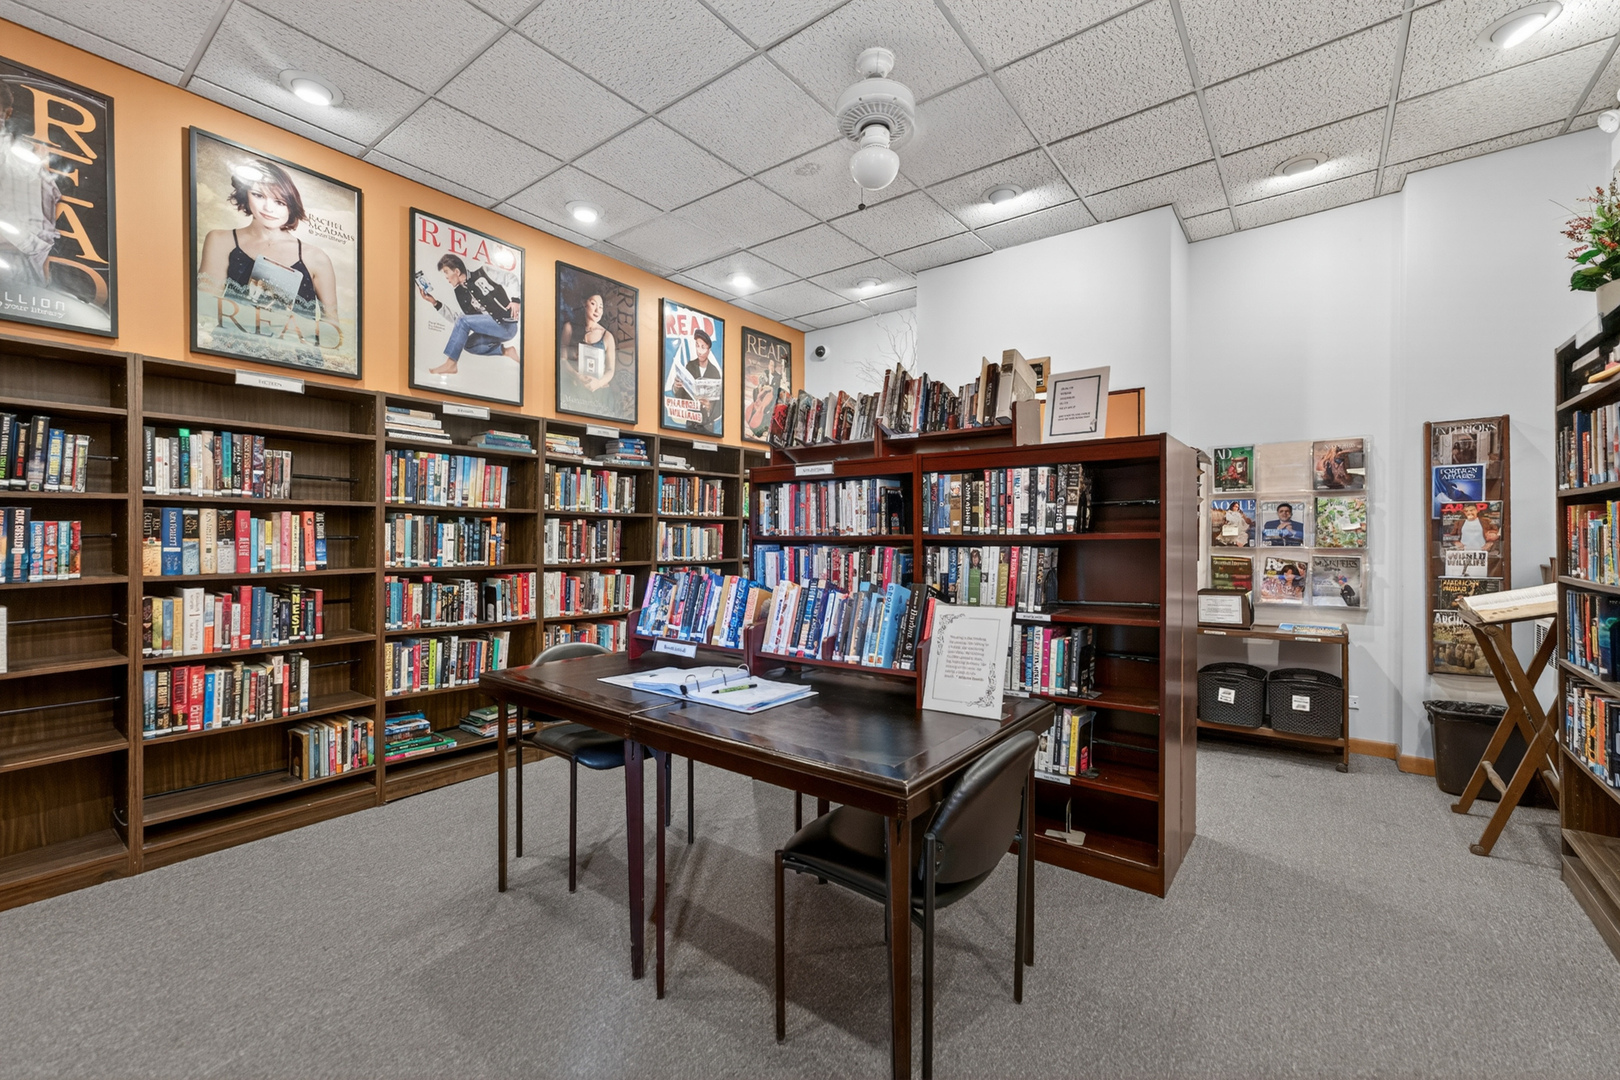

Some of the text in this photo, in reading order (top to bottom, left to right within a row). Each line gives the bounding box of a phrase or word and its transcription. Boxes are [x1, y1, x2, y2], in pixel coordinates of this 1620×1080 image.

[418, 216, 517, 272] READ
[30, 307, 66, 319] library
[213, 296, 344, 350] READ
[616, 286, 635, 370] READ
[666, 313, 714, 337] READ
[746, 333, 788, 364] READ
[1440, 467, 1478, 475] FOREIGN
[1212, 500, 1255, 511] VOUE
[291, 593, 300, 636] NEST
